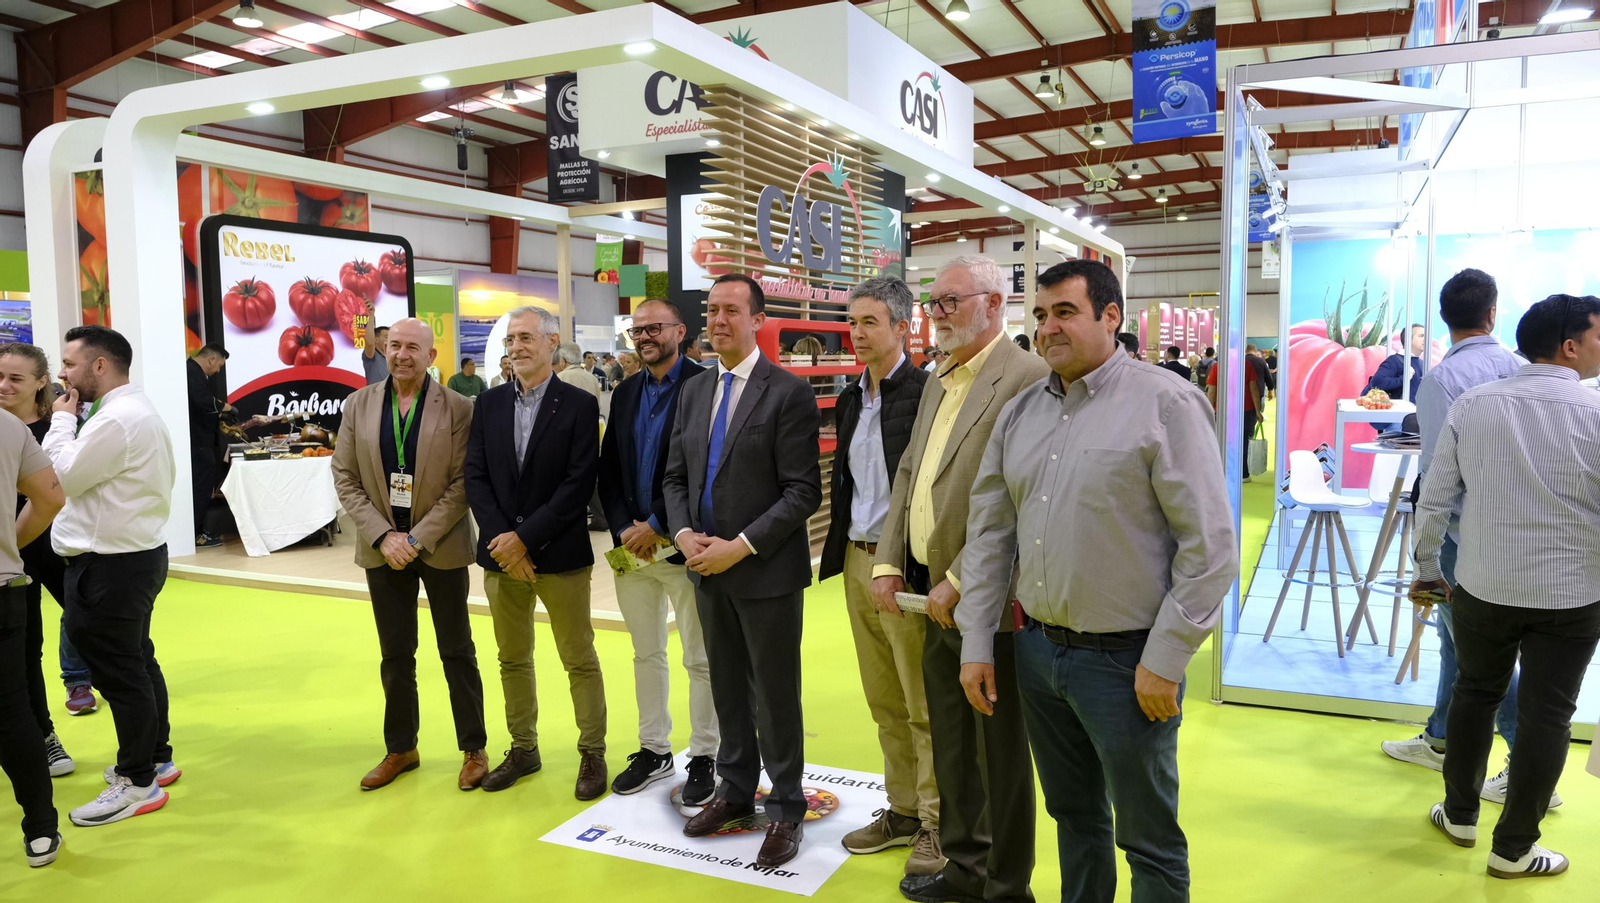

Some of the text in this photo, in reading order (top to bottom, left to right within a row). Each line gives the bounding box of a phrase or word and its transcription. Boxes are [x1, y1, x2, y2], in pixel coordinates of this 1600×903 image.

[1160, 50, 1196, 61] Persicop
[644, 70, 719, 116] CA
[900, 79, 938, 139] CASI
[559, 161, 580, 169] MALLAS
[557, 167, 591, 177] PROTECCIÓN
[559, 177, 588, 186] AGRÍCOLA
[756, 184, 842, 273] CASI
[356, 315, 369, 325] SAB
[606, 834, 719, 863] Ayuntamiento
[720, 856, 743, 868] de
